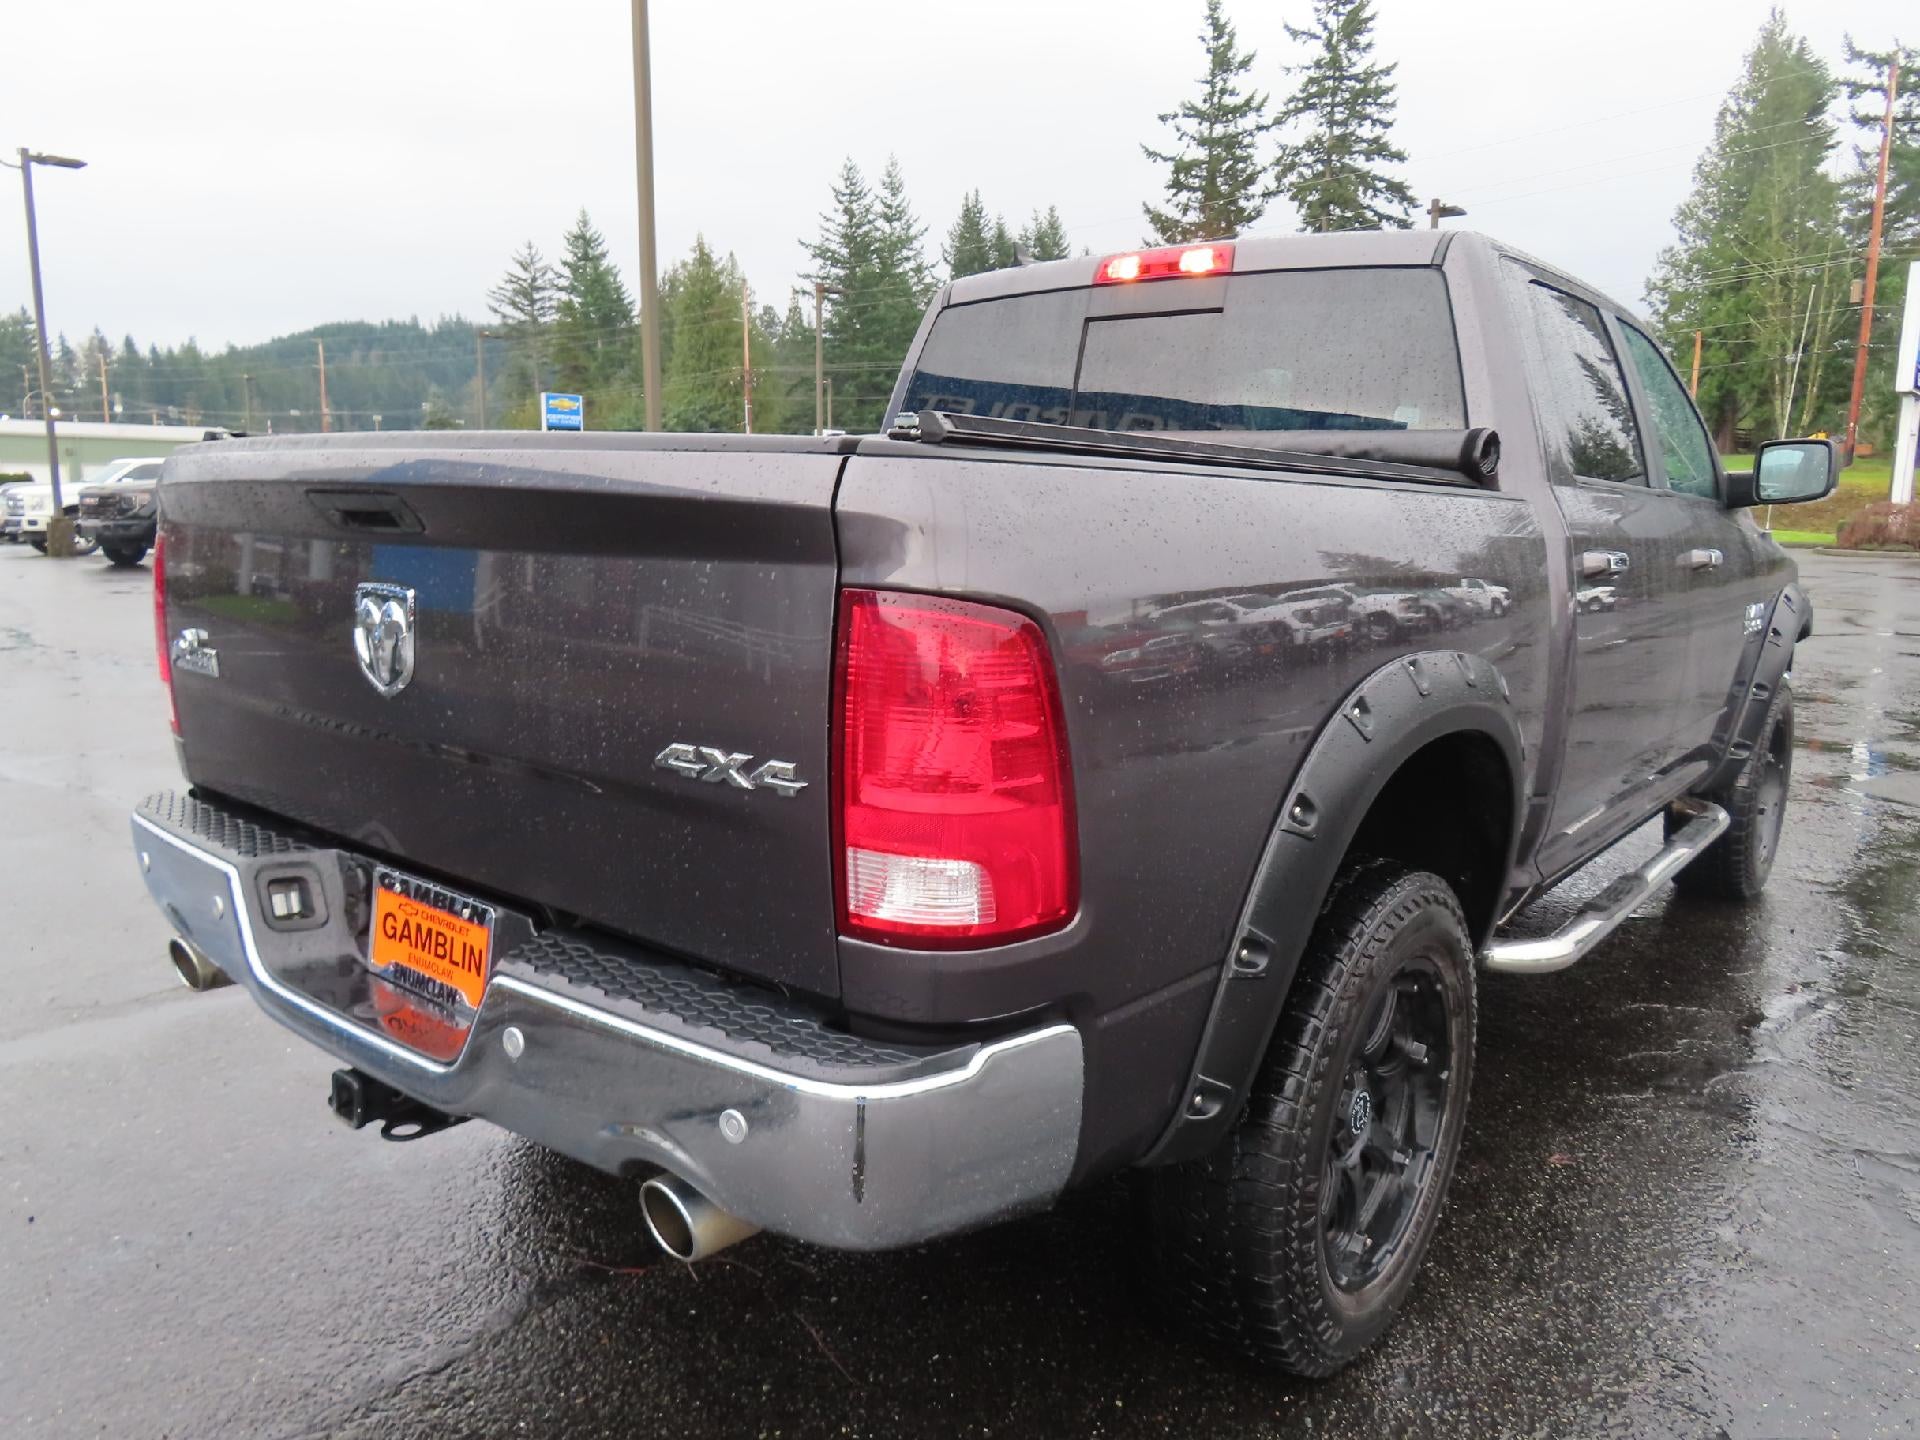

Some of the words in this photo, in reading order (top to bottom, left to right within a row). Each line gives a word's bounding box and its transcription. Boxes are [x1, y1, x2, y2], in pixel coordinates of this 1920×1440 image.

[421, 911, 471, 938] CHEVROLET
[383, 912, 483, 978] GAMBLIN
[408, 952, 454, 980] ENUMCLAW
